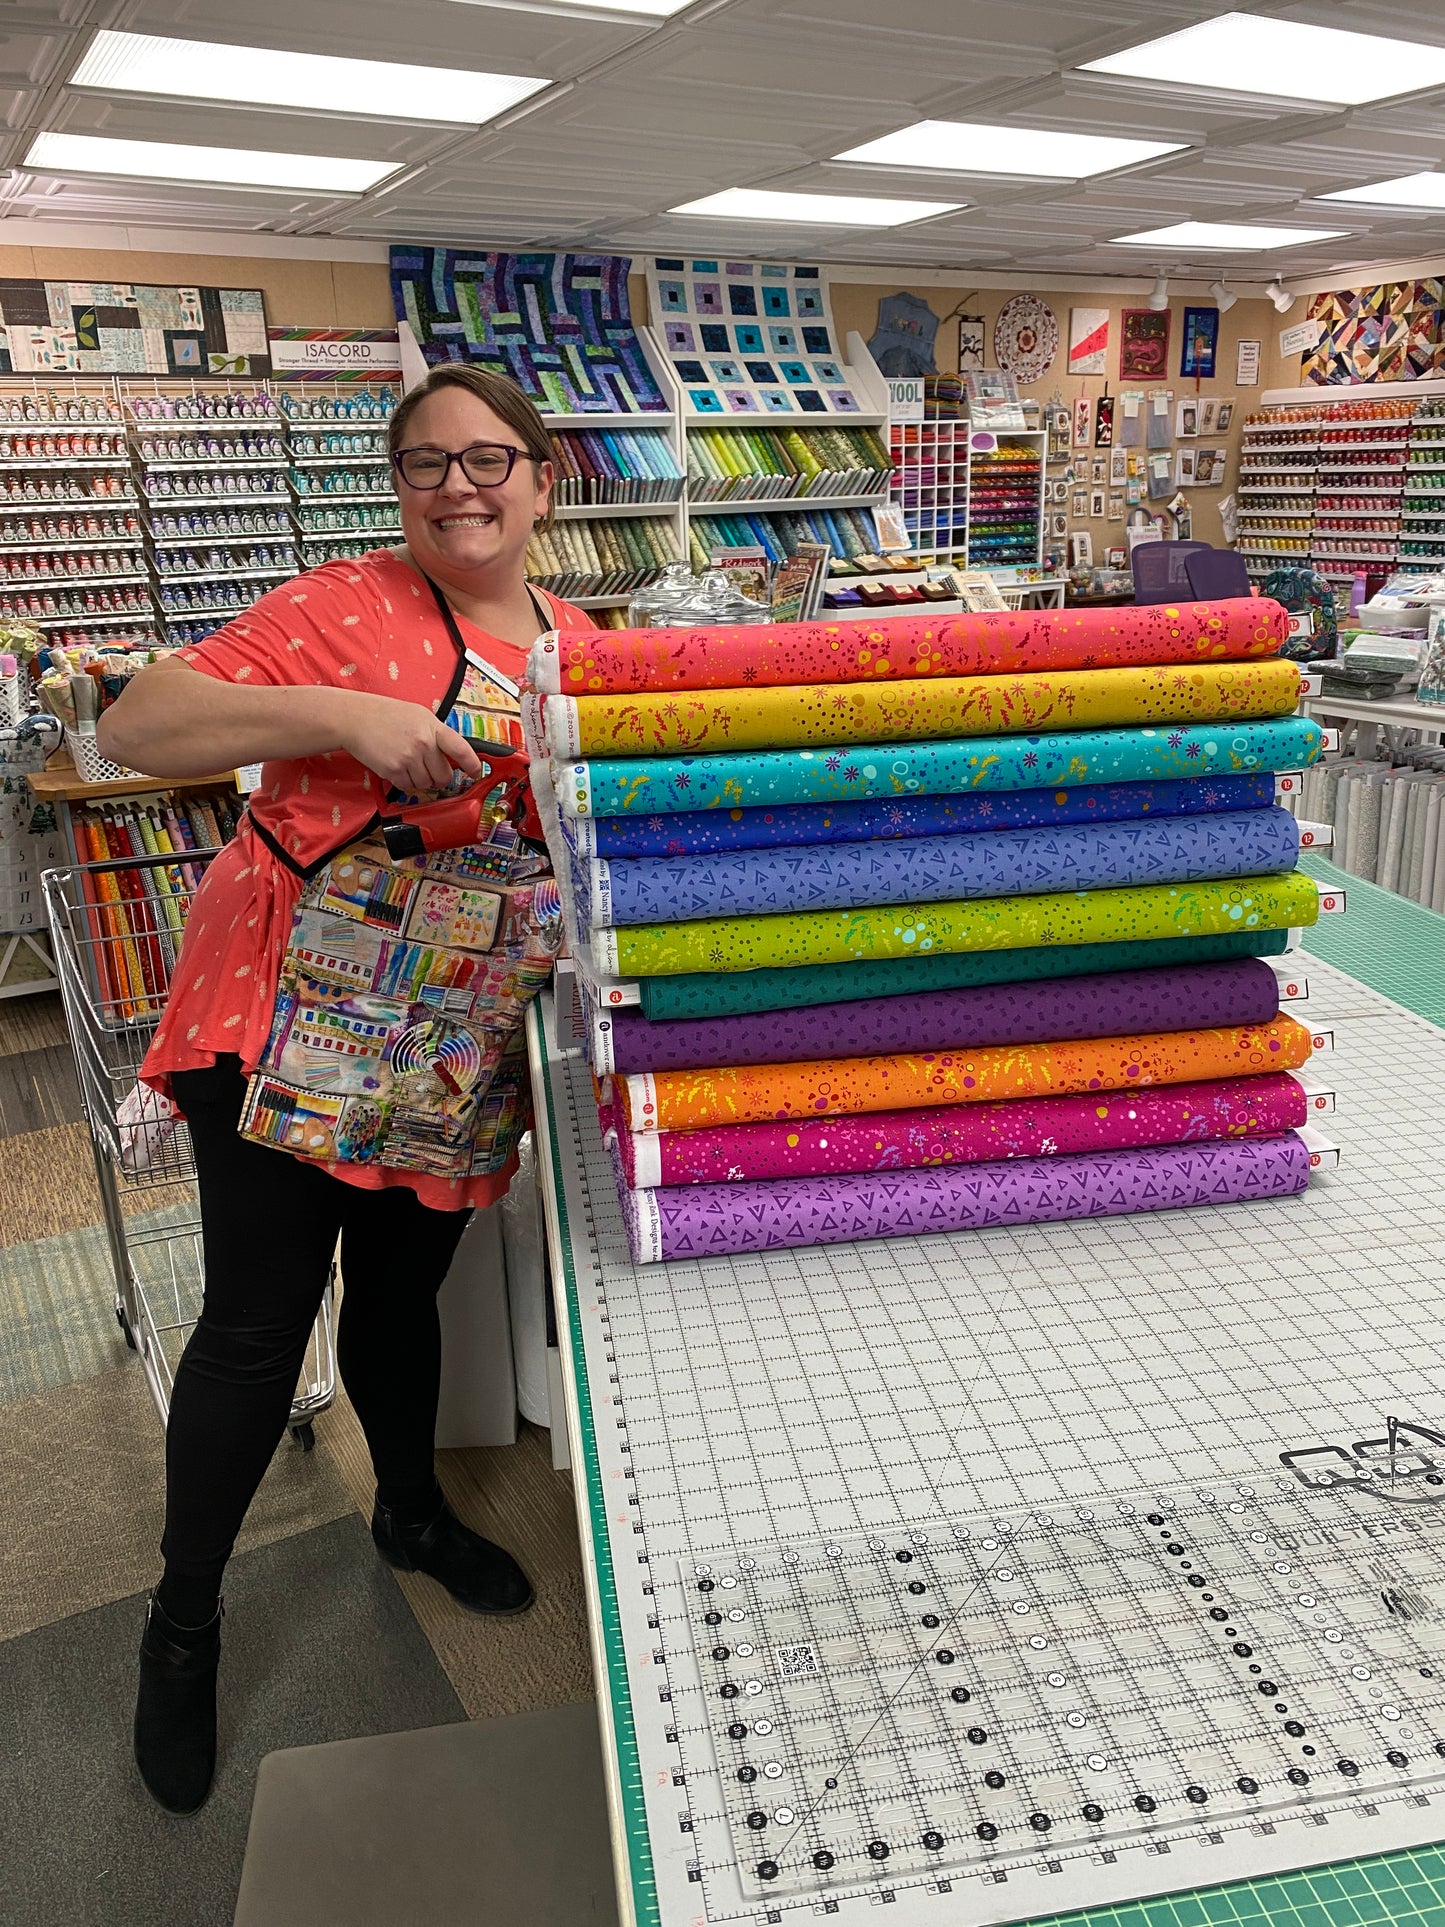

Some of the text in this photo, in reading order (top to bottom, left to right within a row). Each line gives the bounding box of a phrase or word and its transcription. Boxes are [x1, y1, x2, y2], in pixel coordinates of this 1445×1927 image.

[305, 344, 371, 358] ISACORD
[722, 558, 762, 568] Redwork
[584, 822, 592, 847] created
[48, 846, 54, 858] 6
[18, 871, 28, 882] 11
[20, 890, 30, 904] 17
[599, 891, 610, 912] Nancy
[602, 1032, 610, 1060] andover
[649, 1218, 660, 1244] Designs
